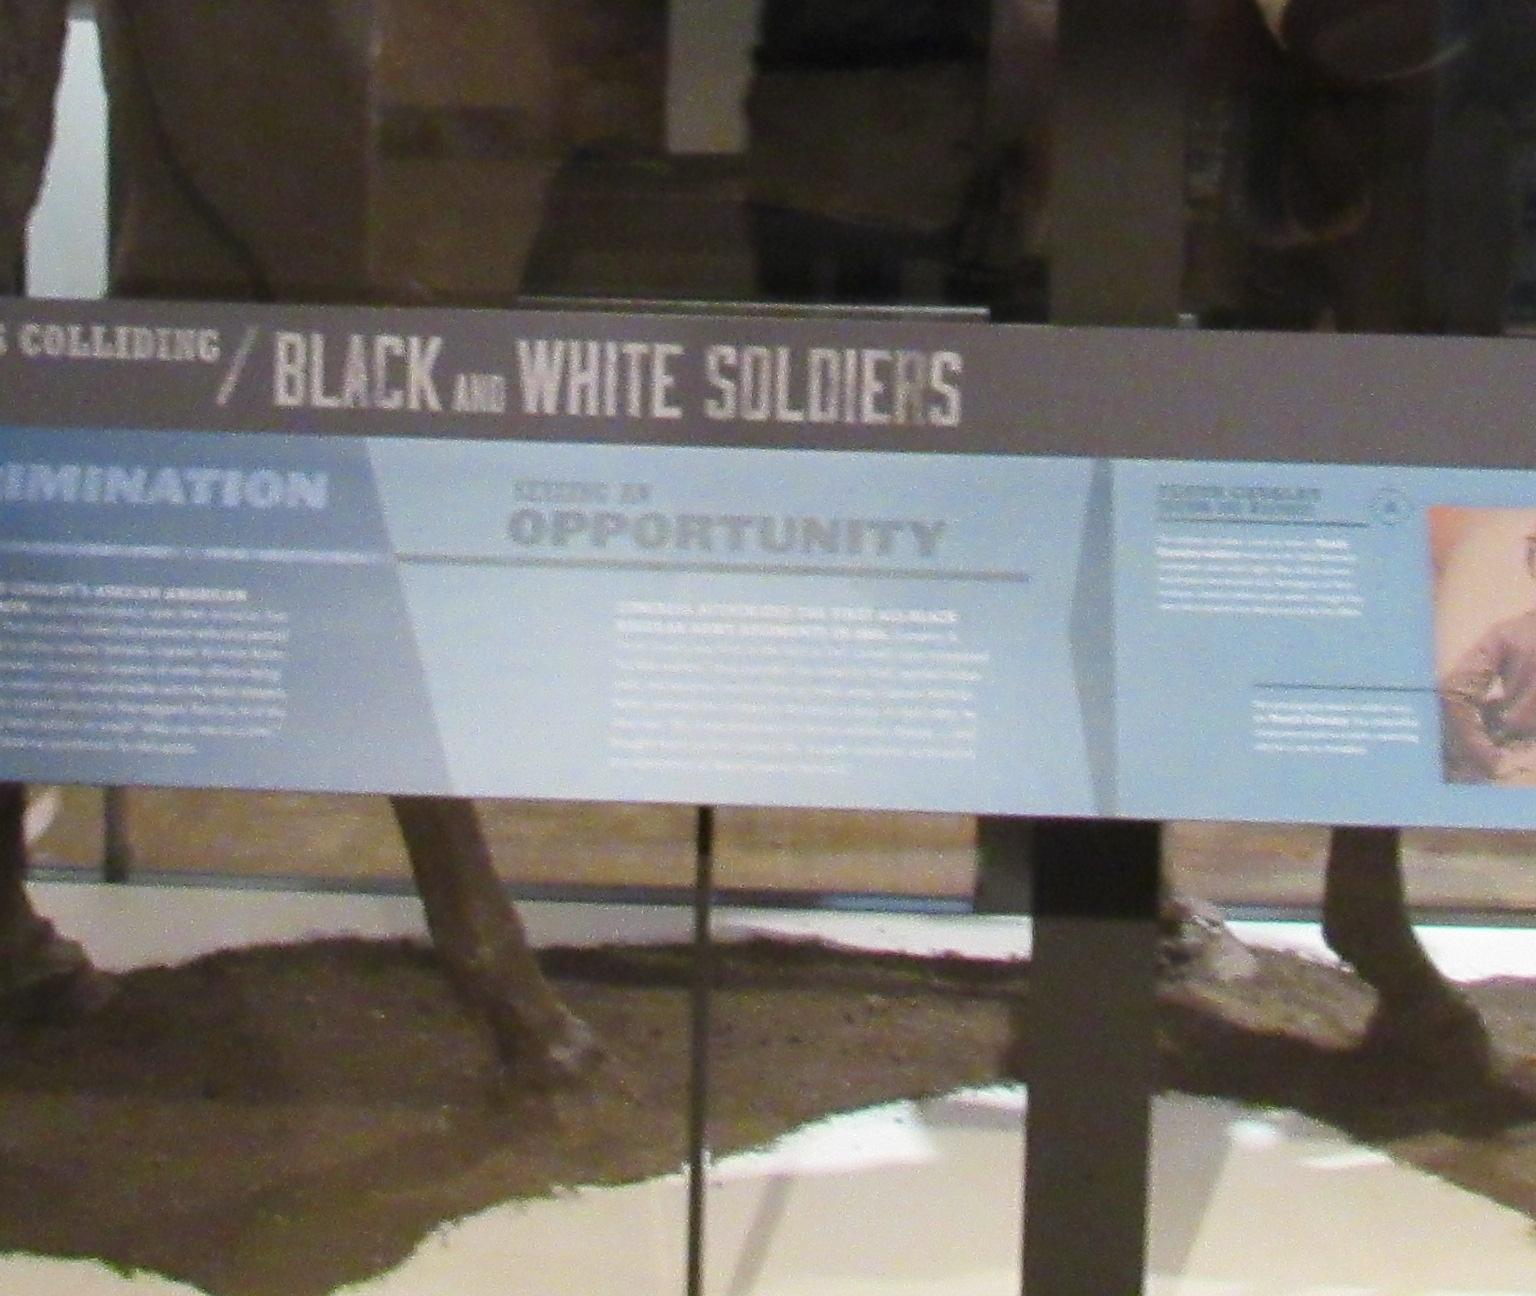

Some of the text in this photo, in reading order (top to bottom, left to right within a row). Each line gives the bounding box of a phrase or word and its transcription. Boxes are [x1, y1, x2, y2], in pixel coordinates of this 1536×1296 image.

[17, 322, 222, 364] COLLIDING
[273, 330, 444, 411] BLACK
[451, 373, 507, 414] AND
[515, 337, 686, 421] WHITE
[704, 345, 964, 429] SOLDIERS
[507, 507, 949, 558] OPPORTUNITY
